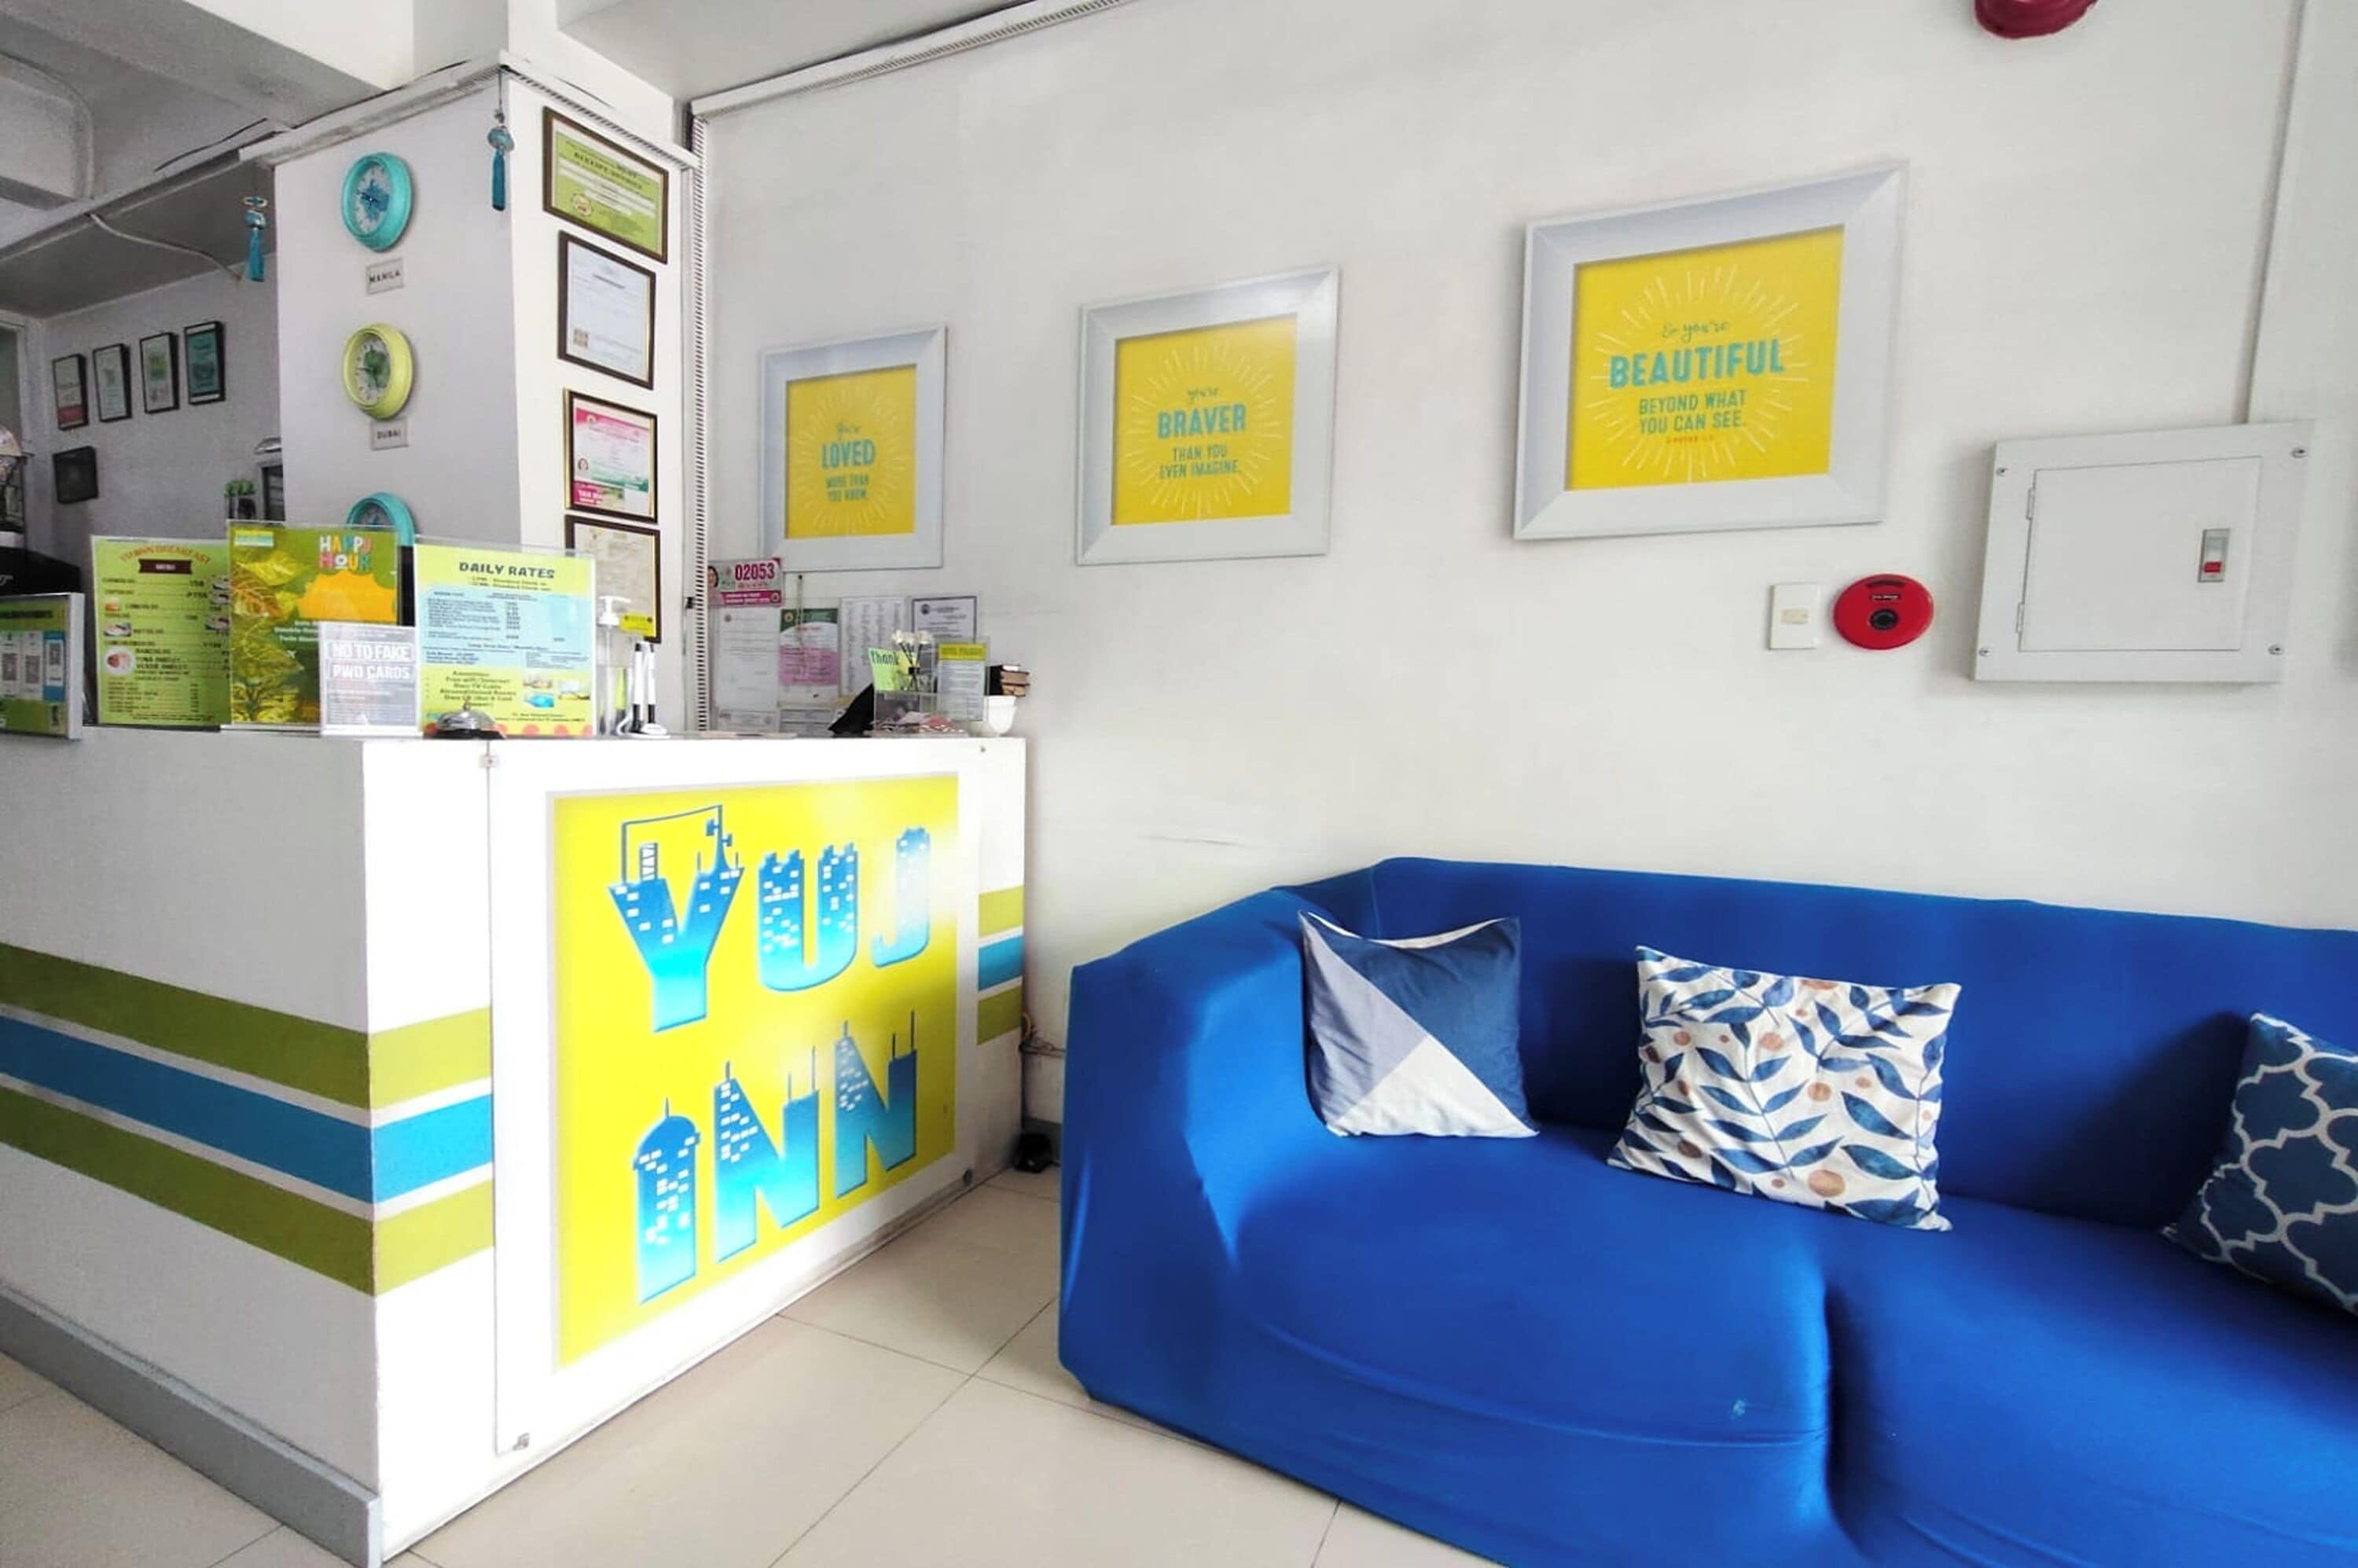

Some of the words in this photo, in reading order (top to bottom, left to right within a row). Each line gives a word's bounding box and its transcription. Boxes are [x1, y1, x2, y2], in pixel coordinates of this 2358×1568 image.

[369, 270, 401, 283] MANILA
[1609, 339, 1786, 388] BEAUTIFUL
[1639, 394, 1699, 415] BEYOND
[1704, 390, 1747, 409] WHAT
[1157, 402, 1247, 440] BRAVER
[1640, 417, 1668, 435] YOU
[1673, 413, 1706, 432] CAN
[821, 439, 876, 470] LOVED
[1172, 445, 1203, 461] THAN
[1207, 444, 1228, 459] YOU
[1159, 462, 1188, 479] EVEN
[1191, 460, 1240, 477] IMAGINE
[319, 553, 370, 571] HOUR
[459, 562, 504, 575] DAILY
[509, 565, 555, 579] RATES
[735, 562, 775, 581] 02053
[331, 641, 353, 659] NO
[354, 643, 373, 660] TO
[374, 644, 410, 661] FAKE
[332, 664, 364, 679] PWD
[366, 665, 410, 680] CARDS
[608, 806, 931, 1033] YUJ
[633, 1010, 917, 1304] INN
